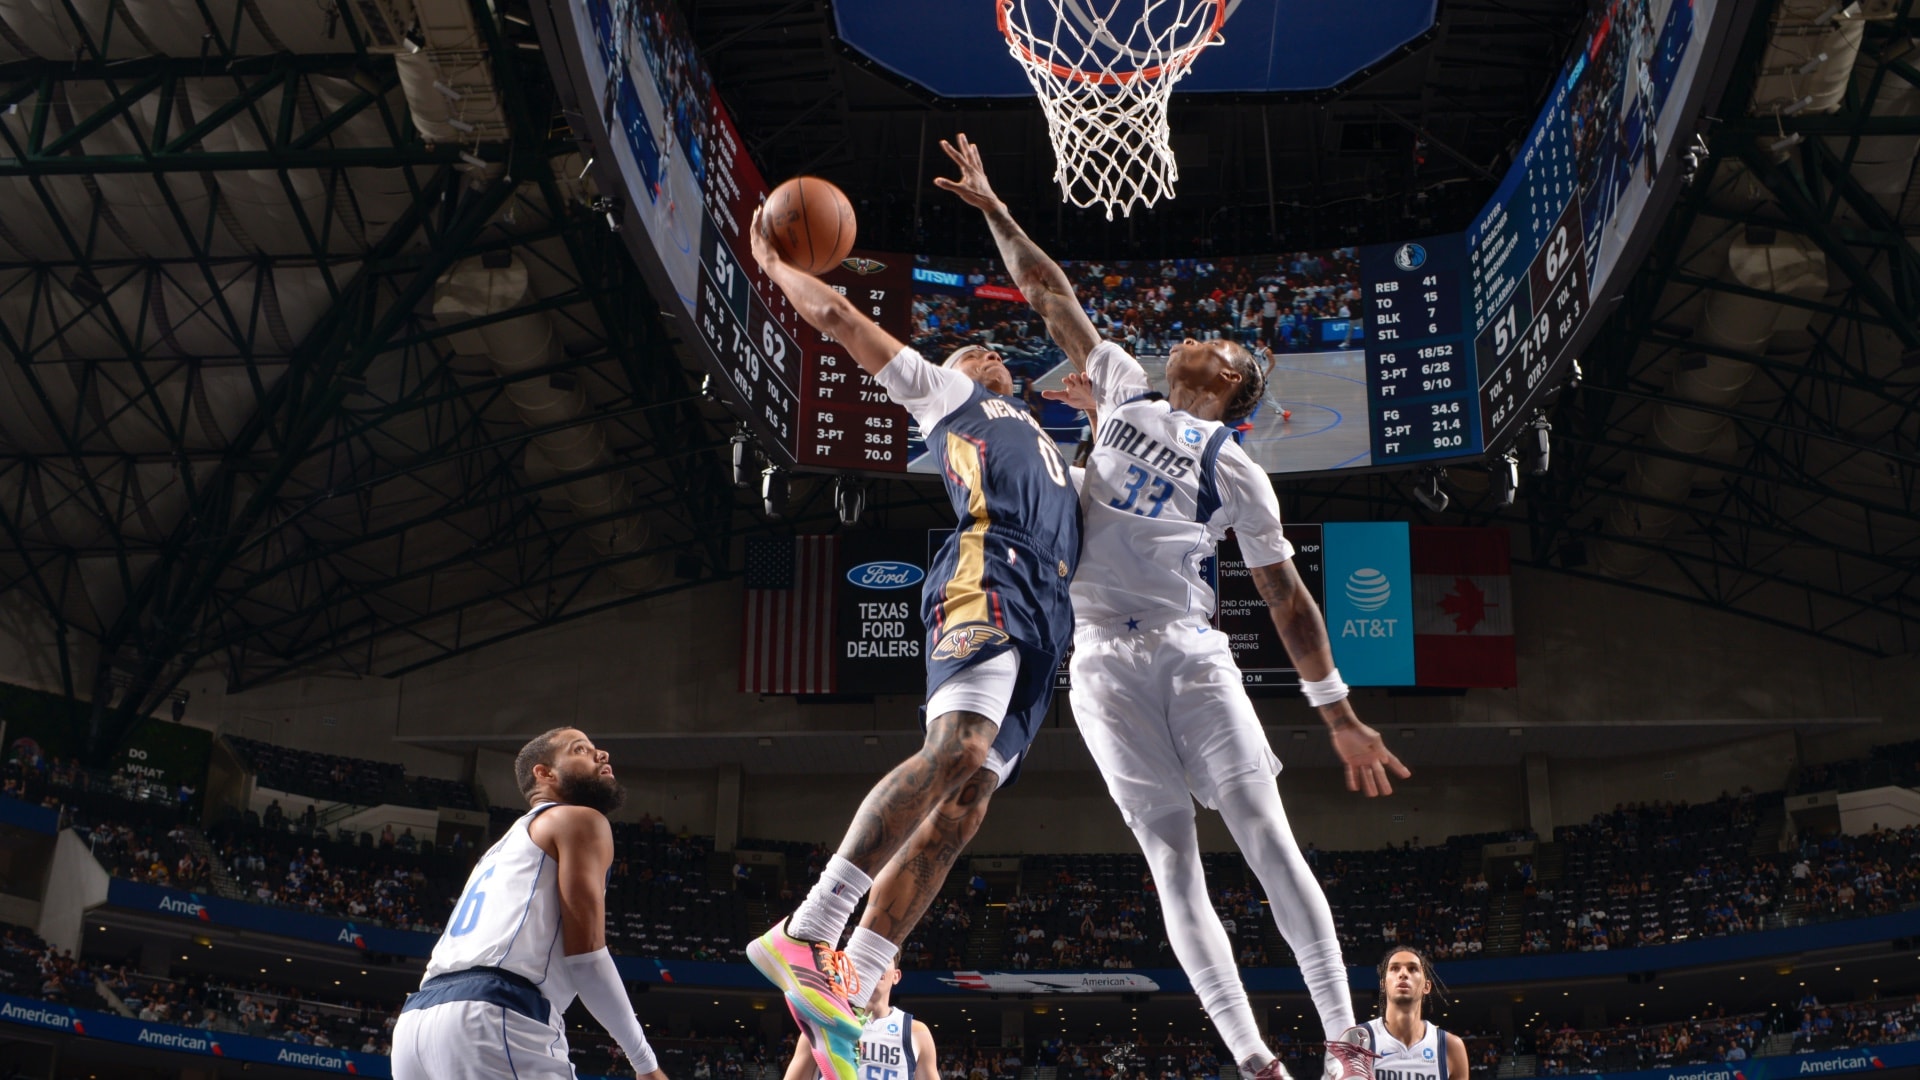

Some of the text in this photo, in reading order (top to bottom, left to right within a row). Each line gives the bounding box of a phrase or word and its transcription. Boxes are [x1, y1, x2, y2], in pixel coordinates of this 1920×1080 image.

[1480, 202, 1502, 234] PLAYER
[1484, 235, 1505, 268] MARTIN
[1484, 232, 1518, 284] WASHINGTON
[913, 268, 959, 286] UTSW
[1376, 275, 1437, 294] REB 41
[870, 290, 885, 300] 27
[1486, 273, 1505, 301] LAWAL
[1494, 226, 1569, 356] 51 62
[715, 241, 786, 373] 51 62
[1376, 292, 1438, 310] TO 15
[872, 306, 881, 316] 8
[1377, 307, 1436, 325] BLK 7
[1378, 323, 1438, 341] STL 6
[1489, 272, 1577, 402] TOL 5 7:19 TOL 4
[705, 284, 788, 413] TOL 5 7:19 TOL 4
[1380, 344, 1454, 364] FG 18/52
[820, 356, 836, 366] FG
[1381, 361, 1450, 380] 3-PT 6/28
[1492, 404, 1505, 428] FLS
[1508, 394, 1514, 412] 2
[1542, 354, 1548, 372] 3
[1560, 312, 1572, 340] FLS
[1574, 300, 1580, 318] 3
[704, 314, 716, 340] FLS
[716, 334, 722, 352] 2
[748, 386, 753, 401] 3
[765, 404, 778, 428] FLS
[781, 422, 787, 438] 3
[820, 372, 846, 384] 3-PT
[818, 388, 888, 403] FT 7/10
[1382, 378, 1452, 397] FT 9/10
[818, 412, 893, 428] FG 45.3
[1384, 402, 1460, 422] FG 34.6
[816, 428, 893, 445] 3-PT 36.8
[1384, 418, 1461, 438] 3-PT 21.4
[816, 445, 892, 461] FT 70.0
[1102, 418, 1194, 478] DALLAS
[1385, 435, 1462, 454] FT 90.0
[1038, 436, 1066, 488] 0
[1110, 464, 1174, 518] 33
[862, 565, 909, 584] Ford
[1309, 564, 1319, 572] 16
[858, 602, 909, 620] TEXAS
[1220, 600, 1269, 608] 2ND CHANC
[862, 622, 905, 638] FORD
[1342, 618, 1398, 638] AT&T
[847, 640, 920, 658] DEALERS
[1229, 642, 1260, 650] CORING
[128, 748, 148, 760] DO
[127, 764, 165, 779] WHAT
[450, 864, 496, 938] 6
[1081, 976, 1125, 986] American
[1, 1002, 70, 1028] American
[138, 1028, 206, 1051] American
[278, 1048, 342, 1068] American
[862, 1042, 900, 1066] LLAS
[1800, 1055, 1866, 1074] American
